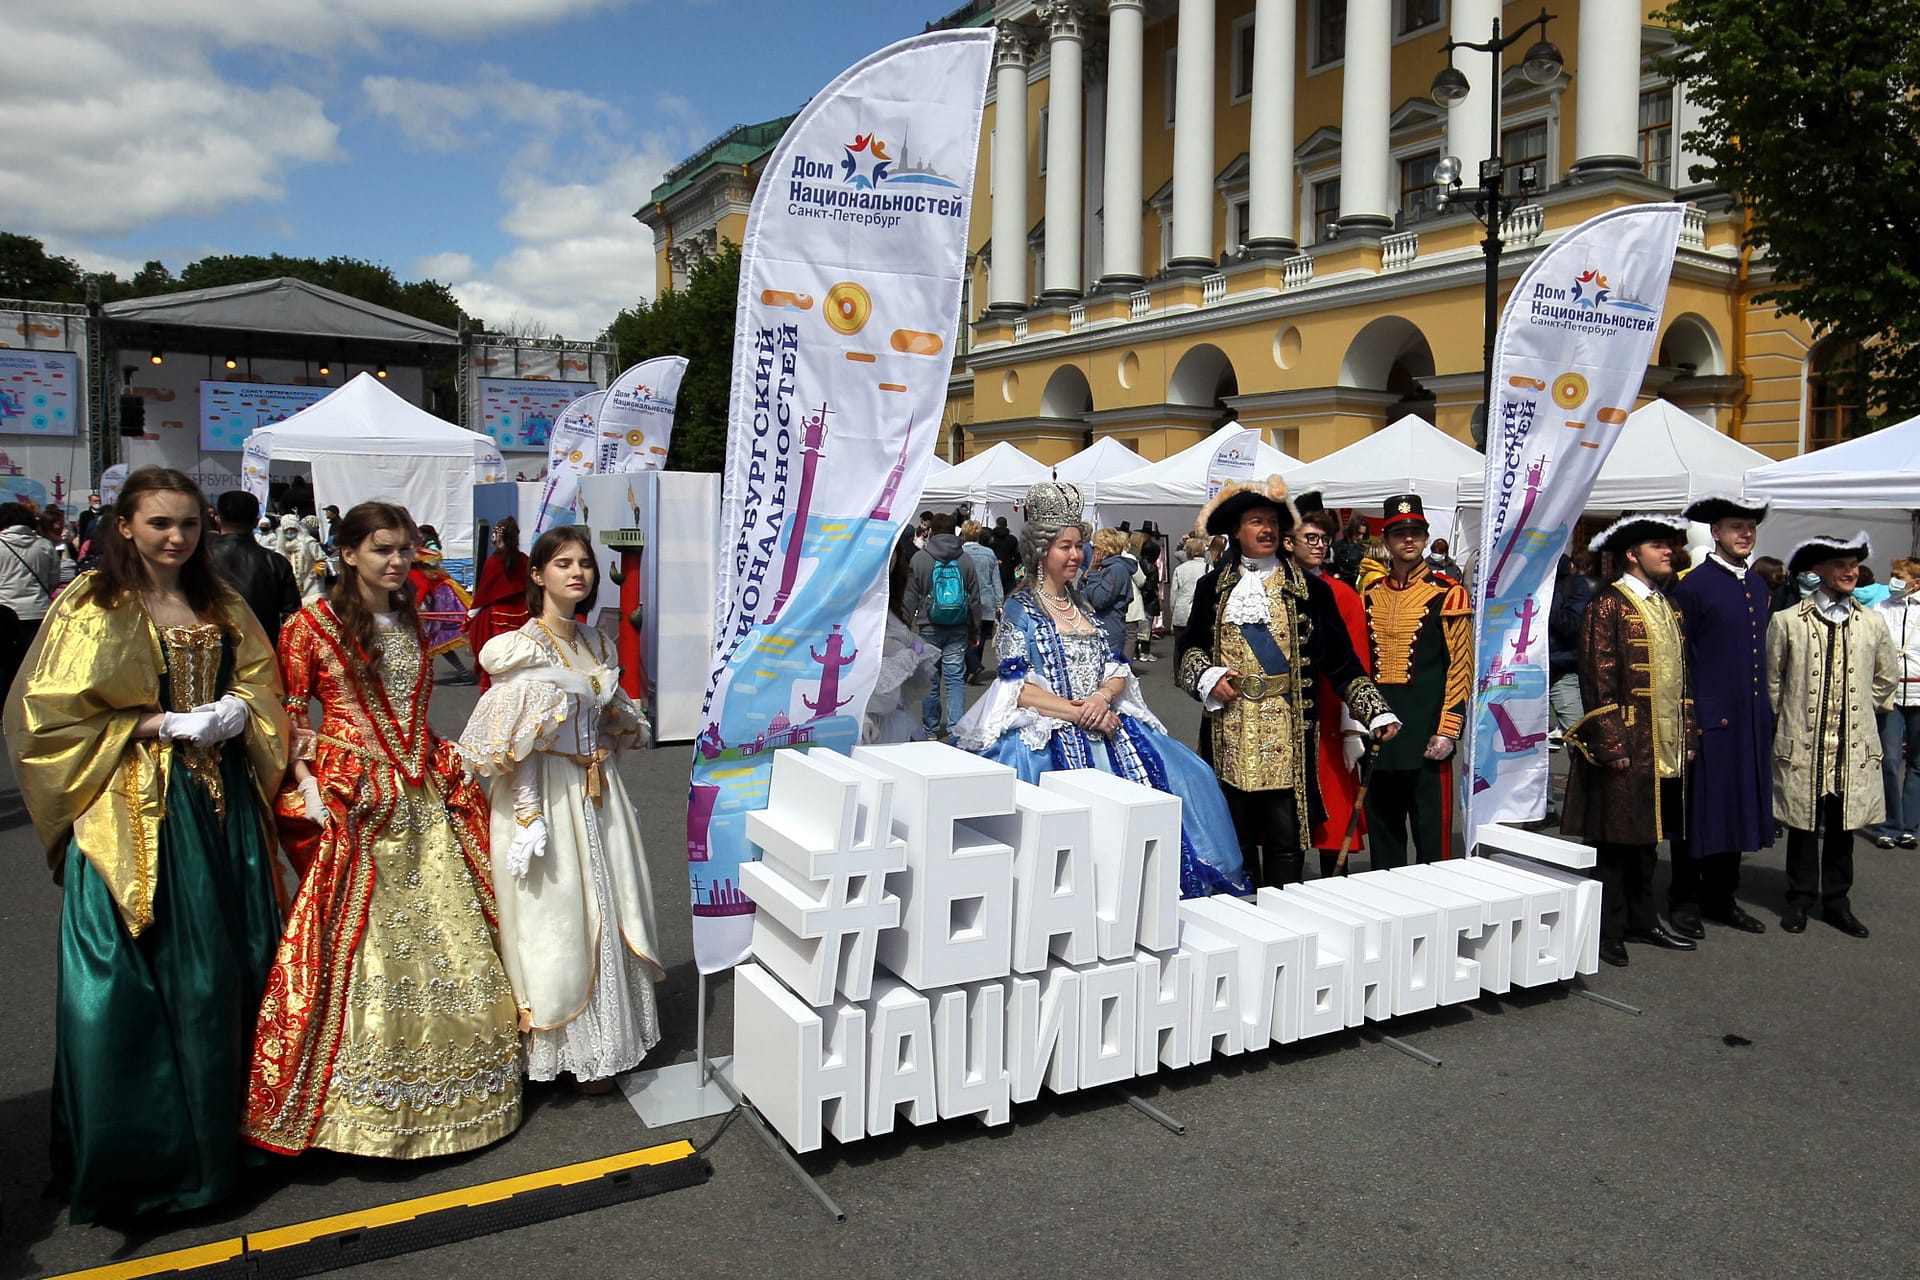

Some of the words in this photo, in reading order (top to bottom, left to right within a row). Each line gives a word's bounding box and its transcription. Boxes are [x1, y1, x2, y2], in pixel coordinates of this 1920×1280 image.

[791, 155, 834, 180] Дом
[789, 181, 963, 218] Национальностей
[788, 203, 902, 229] Санкт-Петербург
[1533, 283, 1566, 301] Дом
[1530, 315, 1618, 337] Санкт-Петербург
[1531, 300, 1655, 332] Национальностей
[614, 389, 631, 399] Дом
[739, 741, 1182, 1008] #БАЛ
[735, 824, 1603, 1154] НАЦИОНАЛЬНОСТЕЙ
